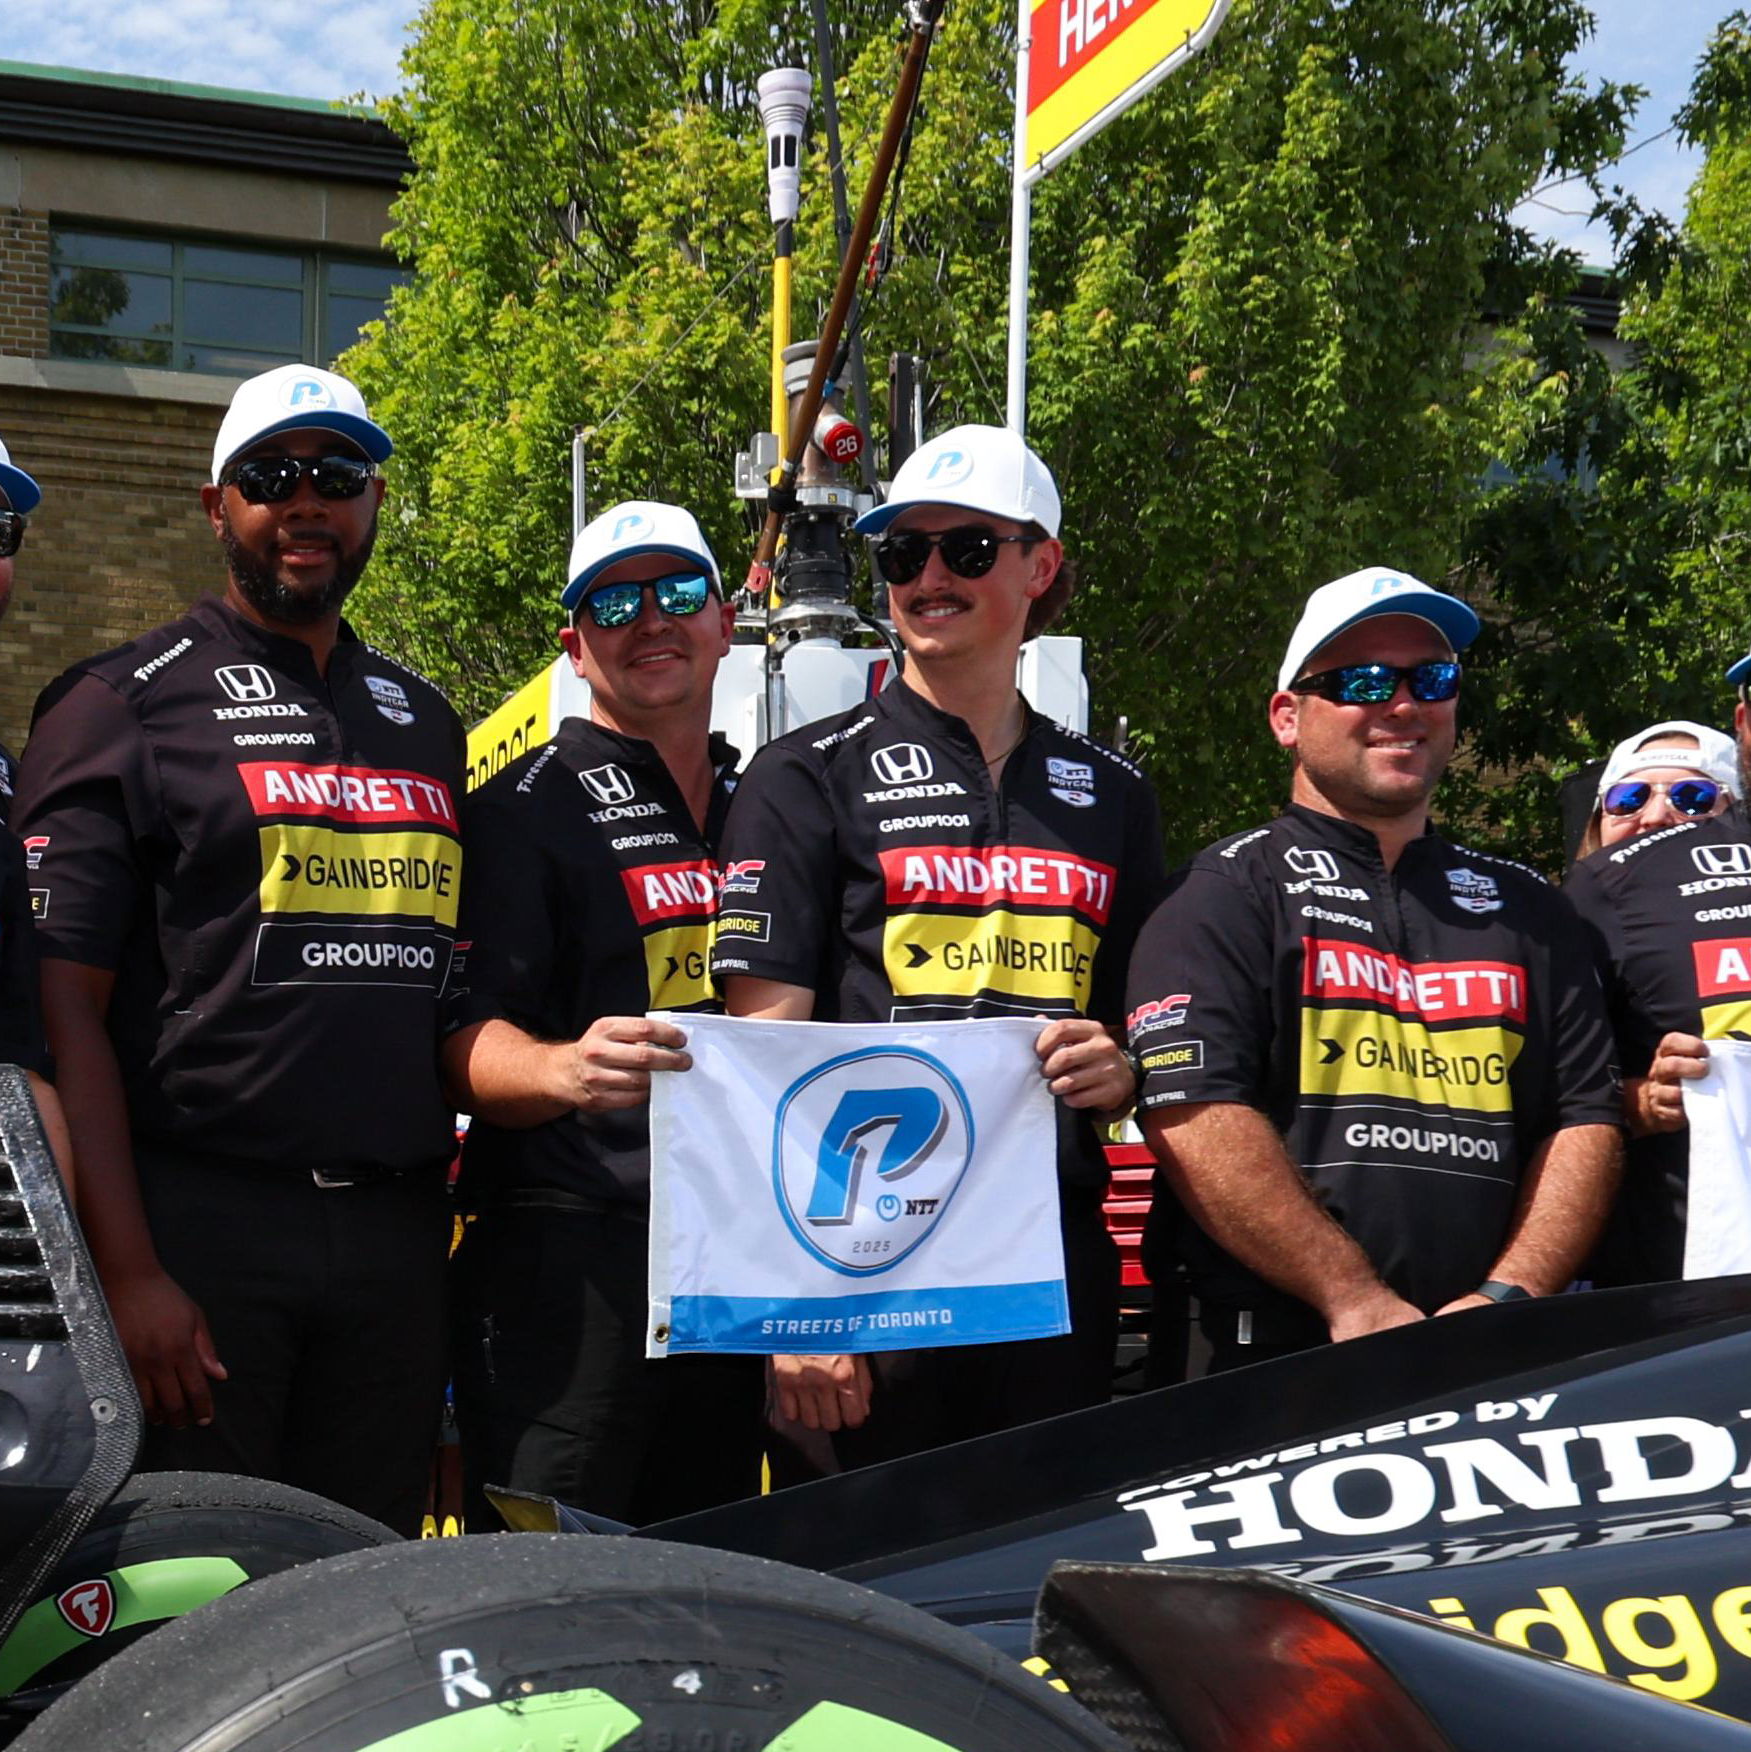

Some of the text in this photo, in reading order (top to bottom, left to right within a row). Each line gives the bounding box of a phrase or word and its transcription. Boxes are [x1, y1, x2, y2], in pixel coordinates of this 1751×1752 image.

[835, 436, 858, 457] 26
[133, 637, 193, 682] Firestone
[213, 703, 308, 720] HONDA
[233, 732, 316, 746] GROUP1001
[265, 769, 450, 820] ANDRETTI
[864, 782, 966, 803] HONDA
[587, 802, 667, 824] HONDA
[879, 814, 970, 833] GROUP1001
[1609, 821, 1698, 865] Firestone
[903, 855, 1109, 911] ANDRETTI
[717, 917, 761, 934] BRIDGE
[302, 941, 436, 971] GROUP100
[943, 936, 1088, 987] GAINBRIDE
[1315, 949, 1521, 1011] ANDRETTI
[1355, 1036, 1506, 1086] GAINBRIDG
[1345, 1123, 1499, 1162] GROUP1001
[904, 1198, 940, 1216] NTT
[852, 1240, 891, 1254] 2025
[761, 1308, 952, 1335] STREETS OF TORONTO
[1475, 1392, 1559, 1424] by
[1122, 1415, 1751, 1562] HOND
[439, 1648, 492, 1708] R
[671, 1668, 703, 1696] 4
